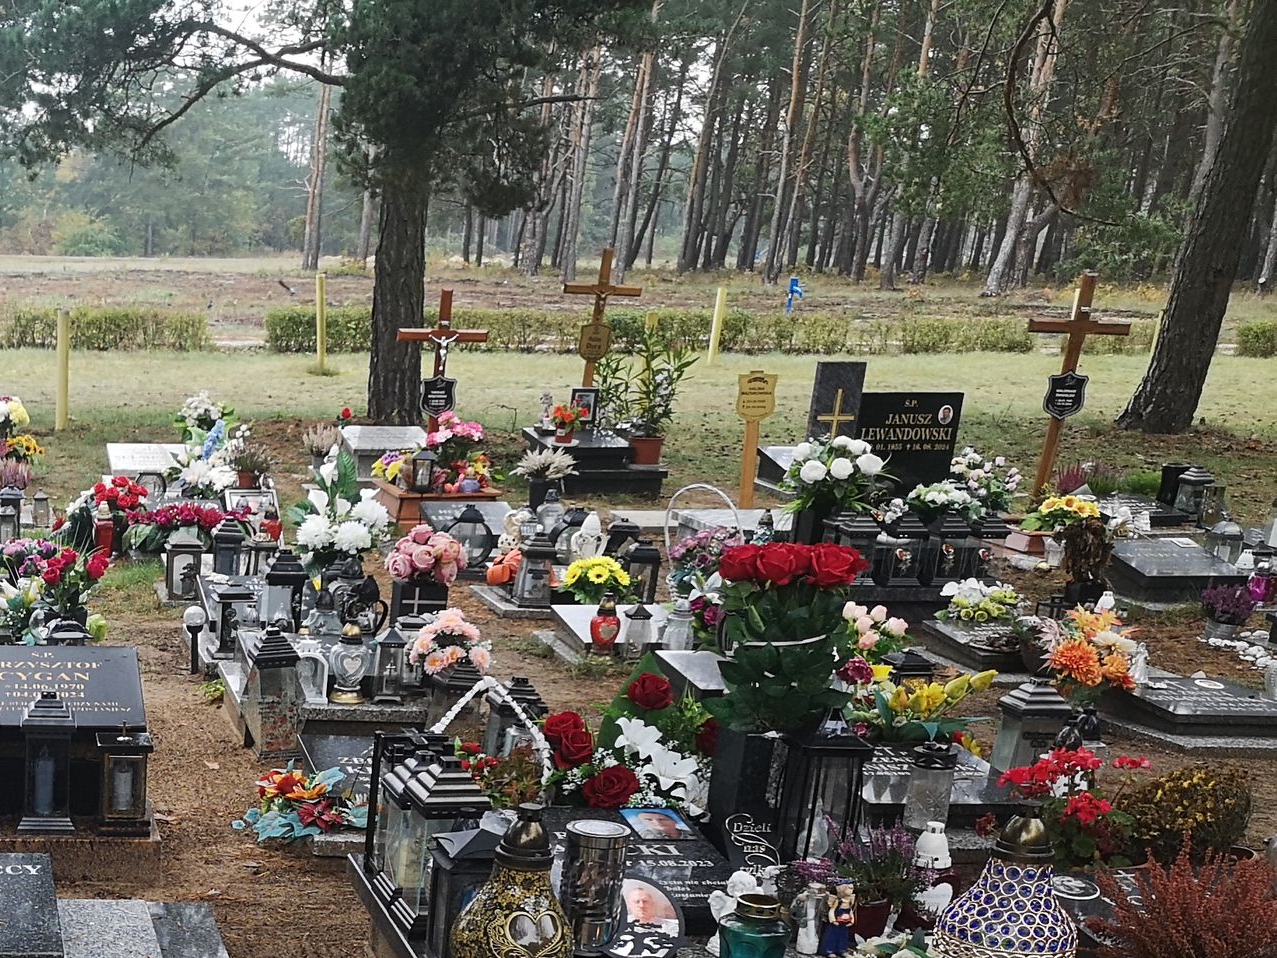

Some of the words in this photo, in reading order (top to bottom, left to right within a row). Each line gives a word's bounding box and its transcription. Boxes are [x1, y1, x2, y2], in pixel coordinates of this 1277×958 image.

[885, 413, 933, 425] JANUSZ
[860, 427, 953, 441] LEWANDOWSKI
[733, 822, 772, 833] Dzieli
[743, 845, 766, 853] nas
